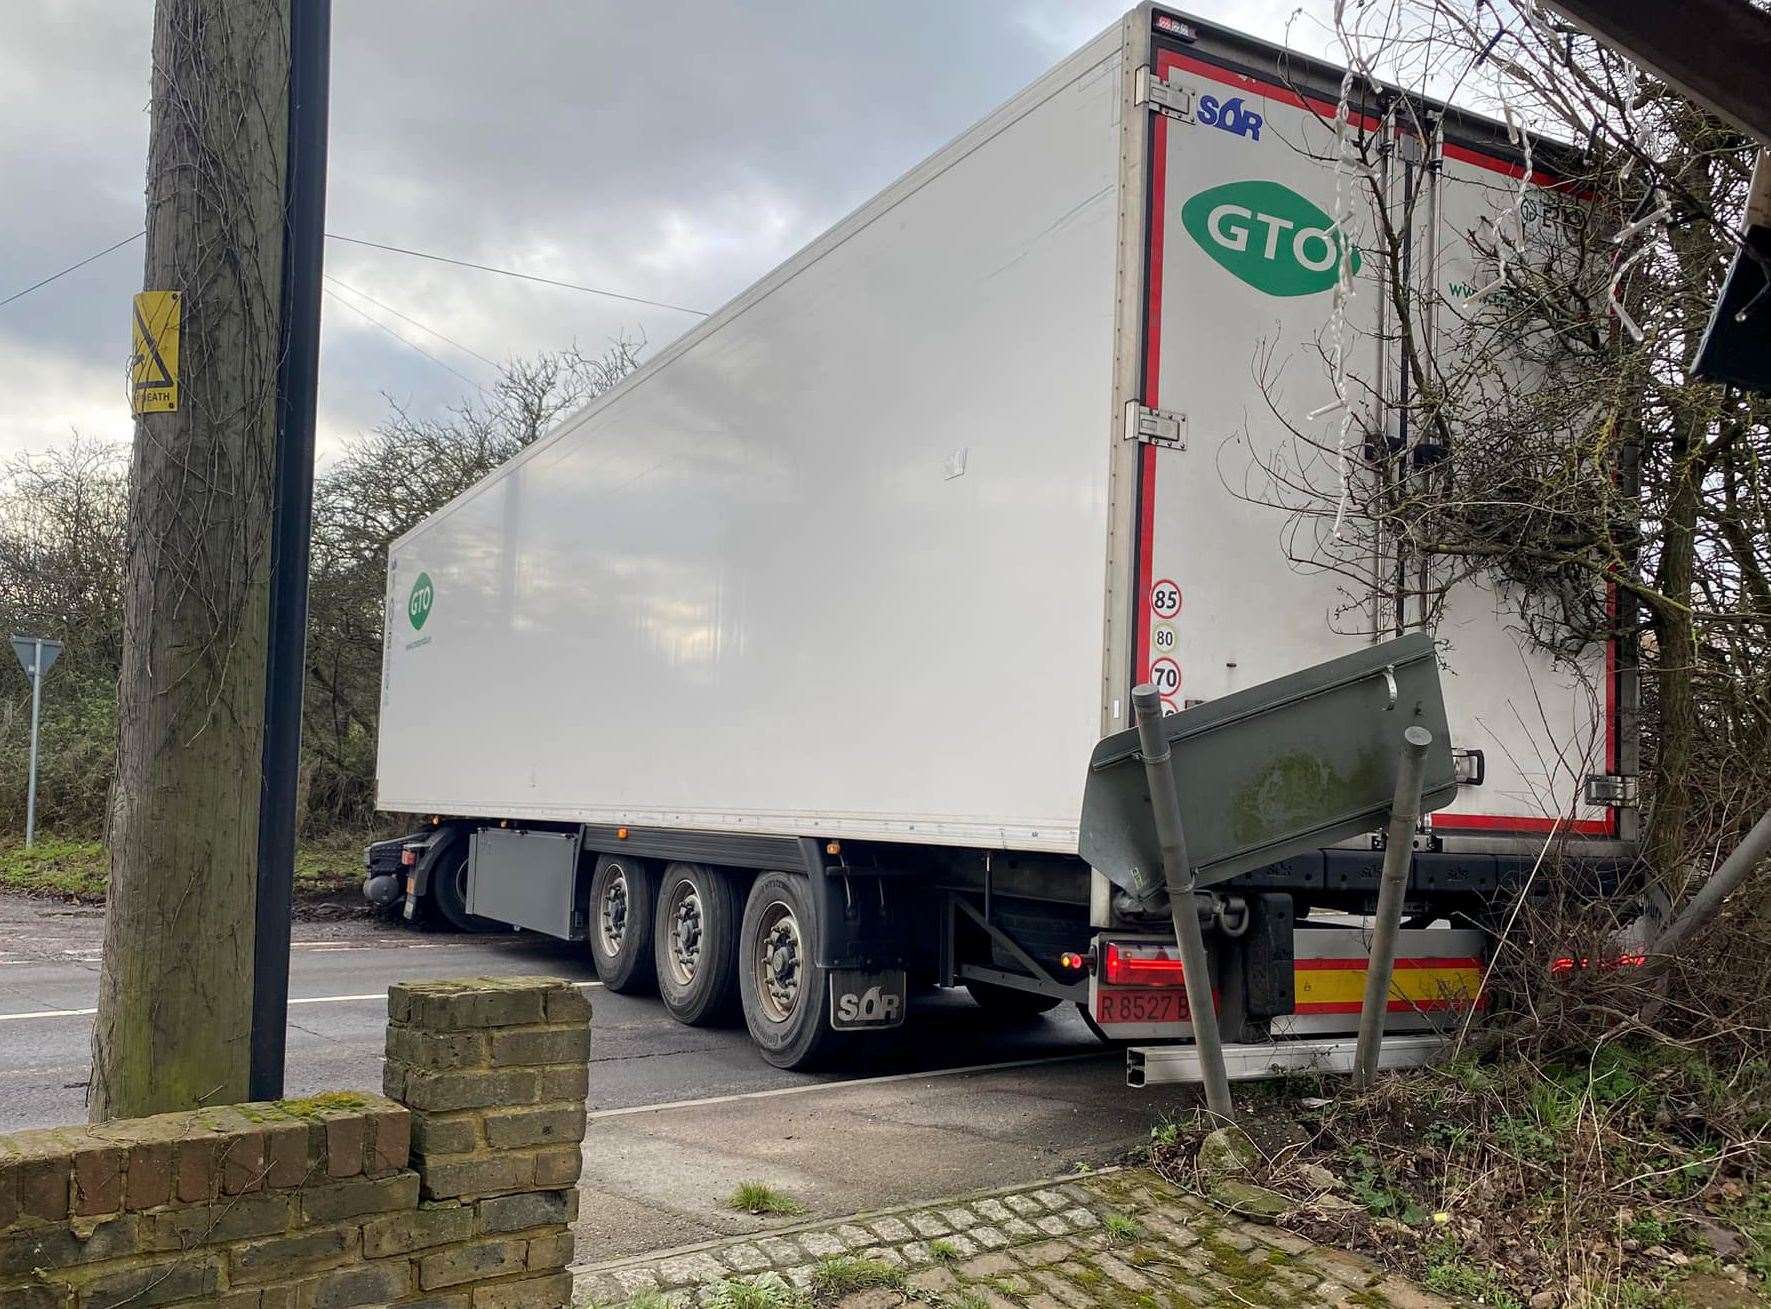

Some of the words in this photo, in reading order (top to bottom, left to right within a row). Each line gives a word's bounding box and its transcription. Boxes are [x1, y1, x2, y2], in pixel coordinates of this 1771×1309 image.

[1207, 204, 1338, 271] GTO
[411, 586, 431, 616] GTO
[1154, 590, 1177, 609] 85
[1156, 631, 1173, 646] 80
[1154, 668, 1177, 687] 70
[1101, 996, 1114, 1020] R
[1120, 996, 1172, 1020] 8527
[1177, 996, 1191, 1020] B
